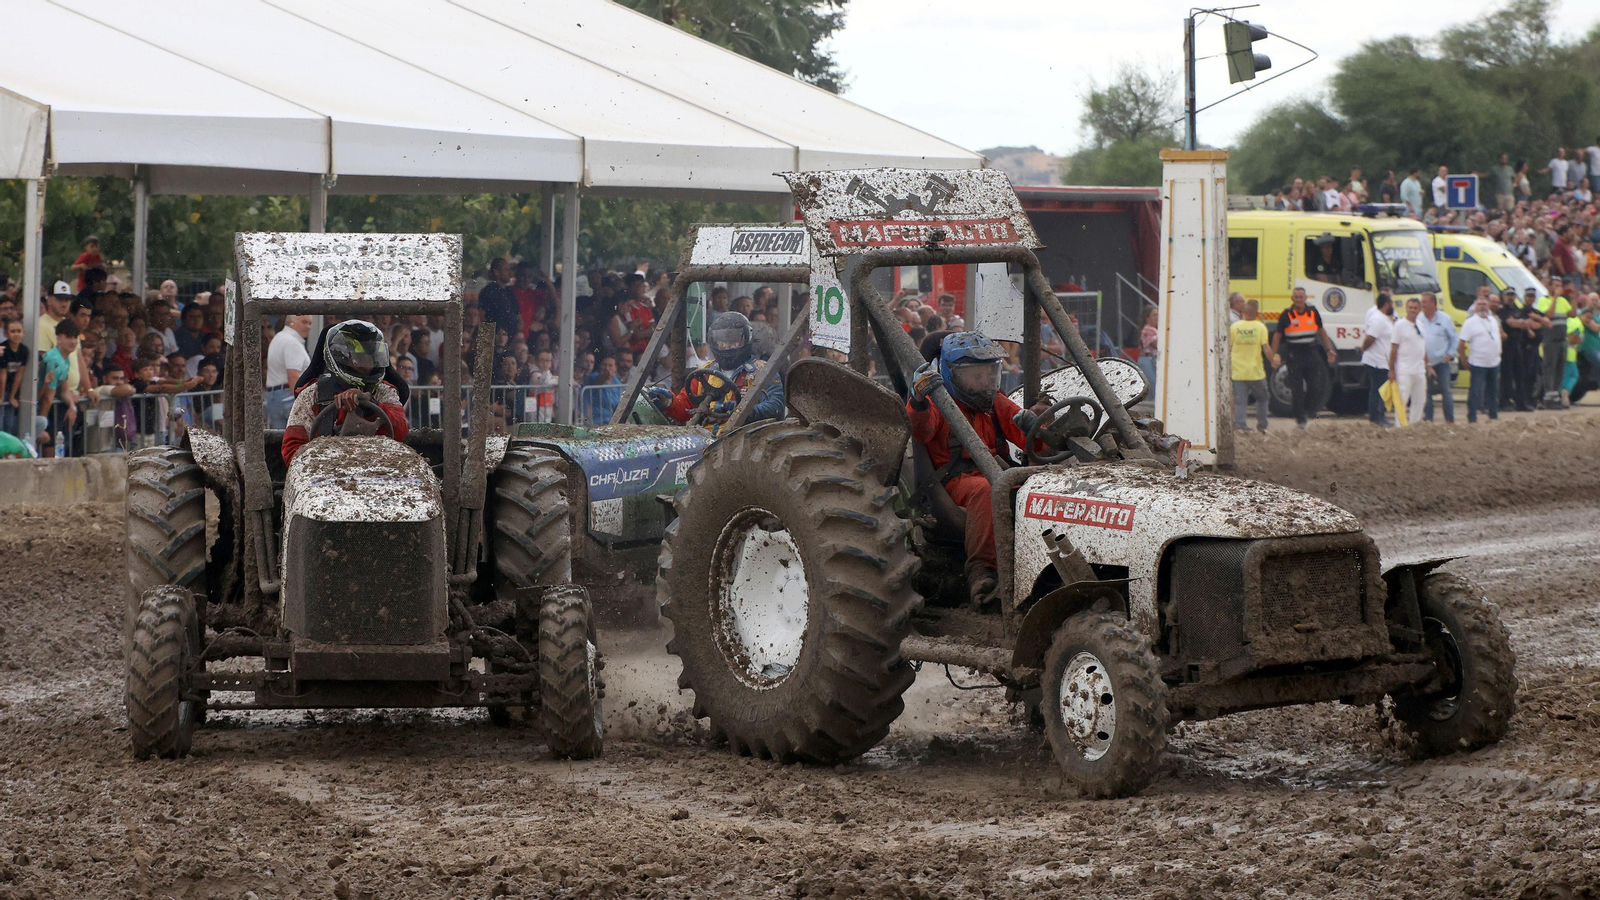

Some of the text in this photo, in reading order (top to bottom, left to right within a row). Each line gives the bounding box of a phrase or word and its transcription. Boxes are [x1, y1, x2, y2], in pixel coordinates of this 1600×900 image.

[269, 244, 351, 258] TURBO
[733, 233, 803, 253] ASFDECOR
[815, 285, 844, 325] 10
[1336, 327, 1366, 339] R-3
[1029, 497, 1131, 526] MAFERAUTO
